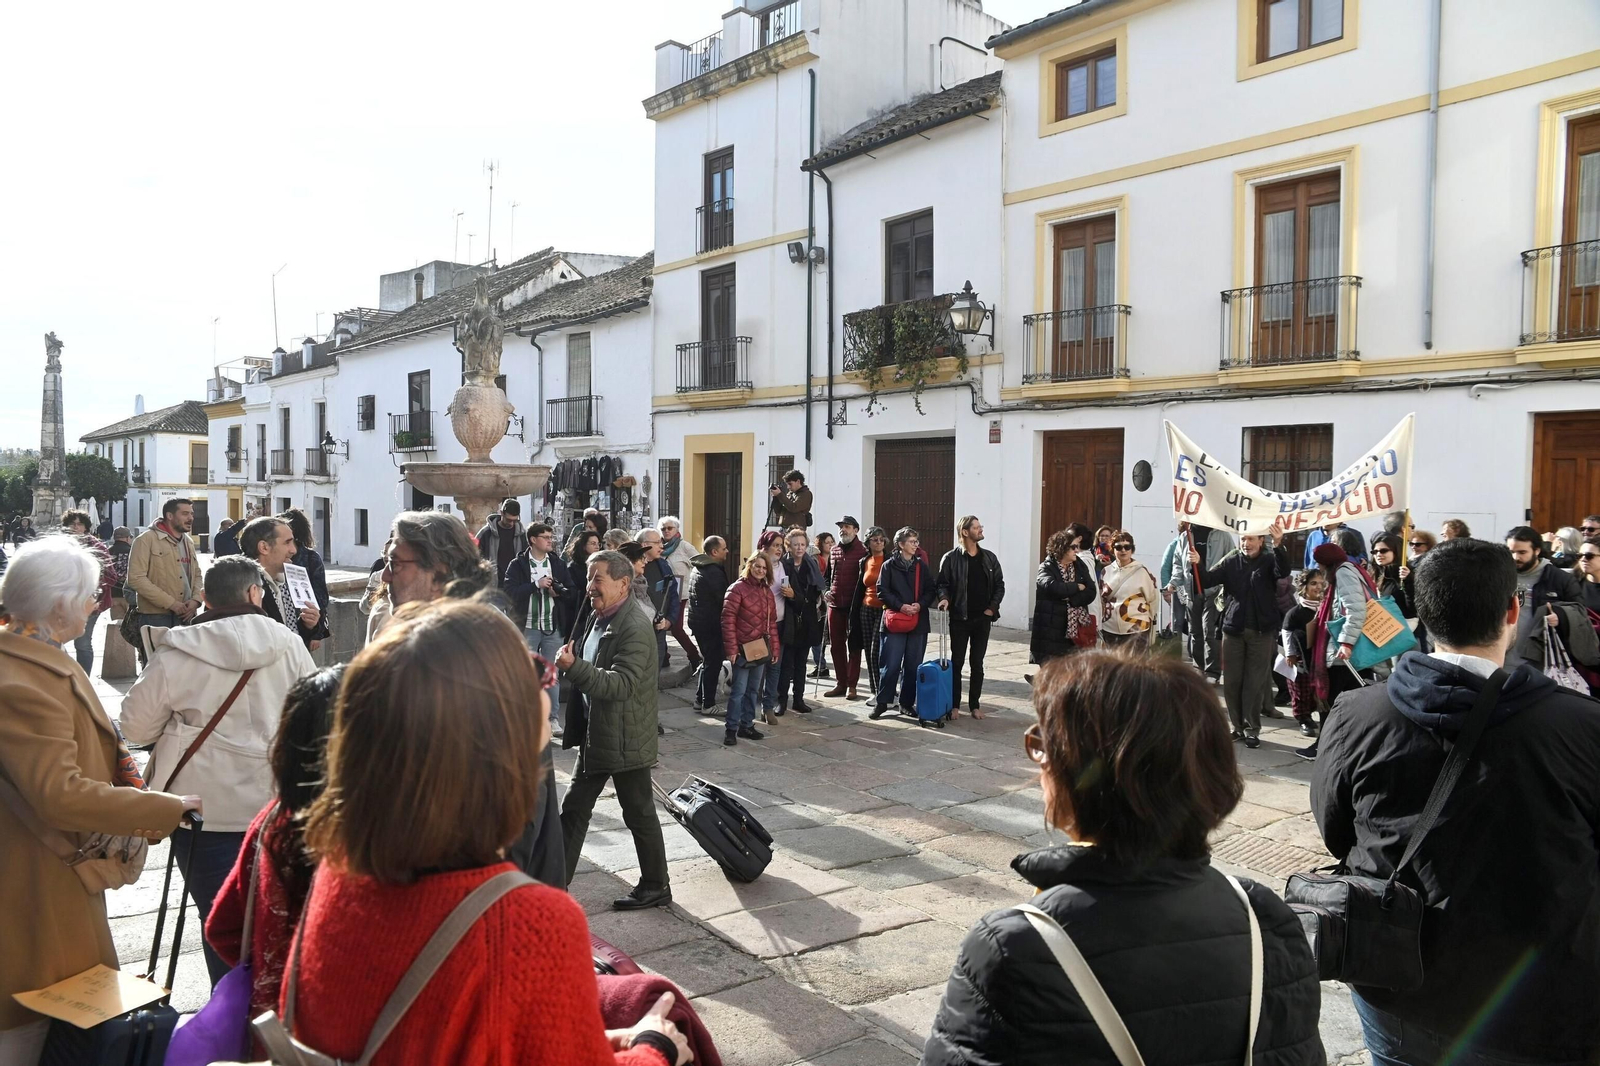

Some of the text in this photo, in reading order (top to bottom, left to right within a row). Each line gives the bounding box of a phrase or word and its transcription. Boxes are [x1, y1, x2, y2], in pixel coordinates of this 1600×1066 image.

[1173, 484, 1204, 516] NO
[1223, 514, 1249, 532] un
[1174, 453, 1208, 487] ES
[1225, 490, 1253, 511] un
